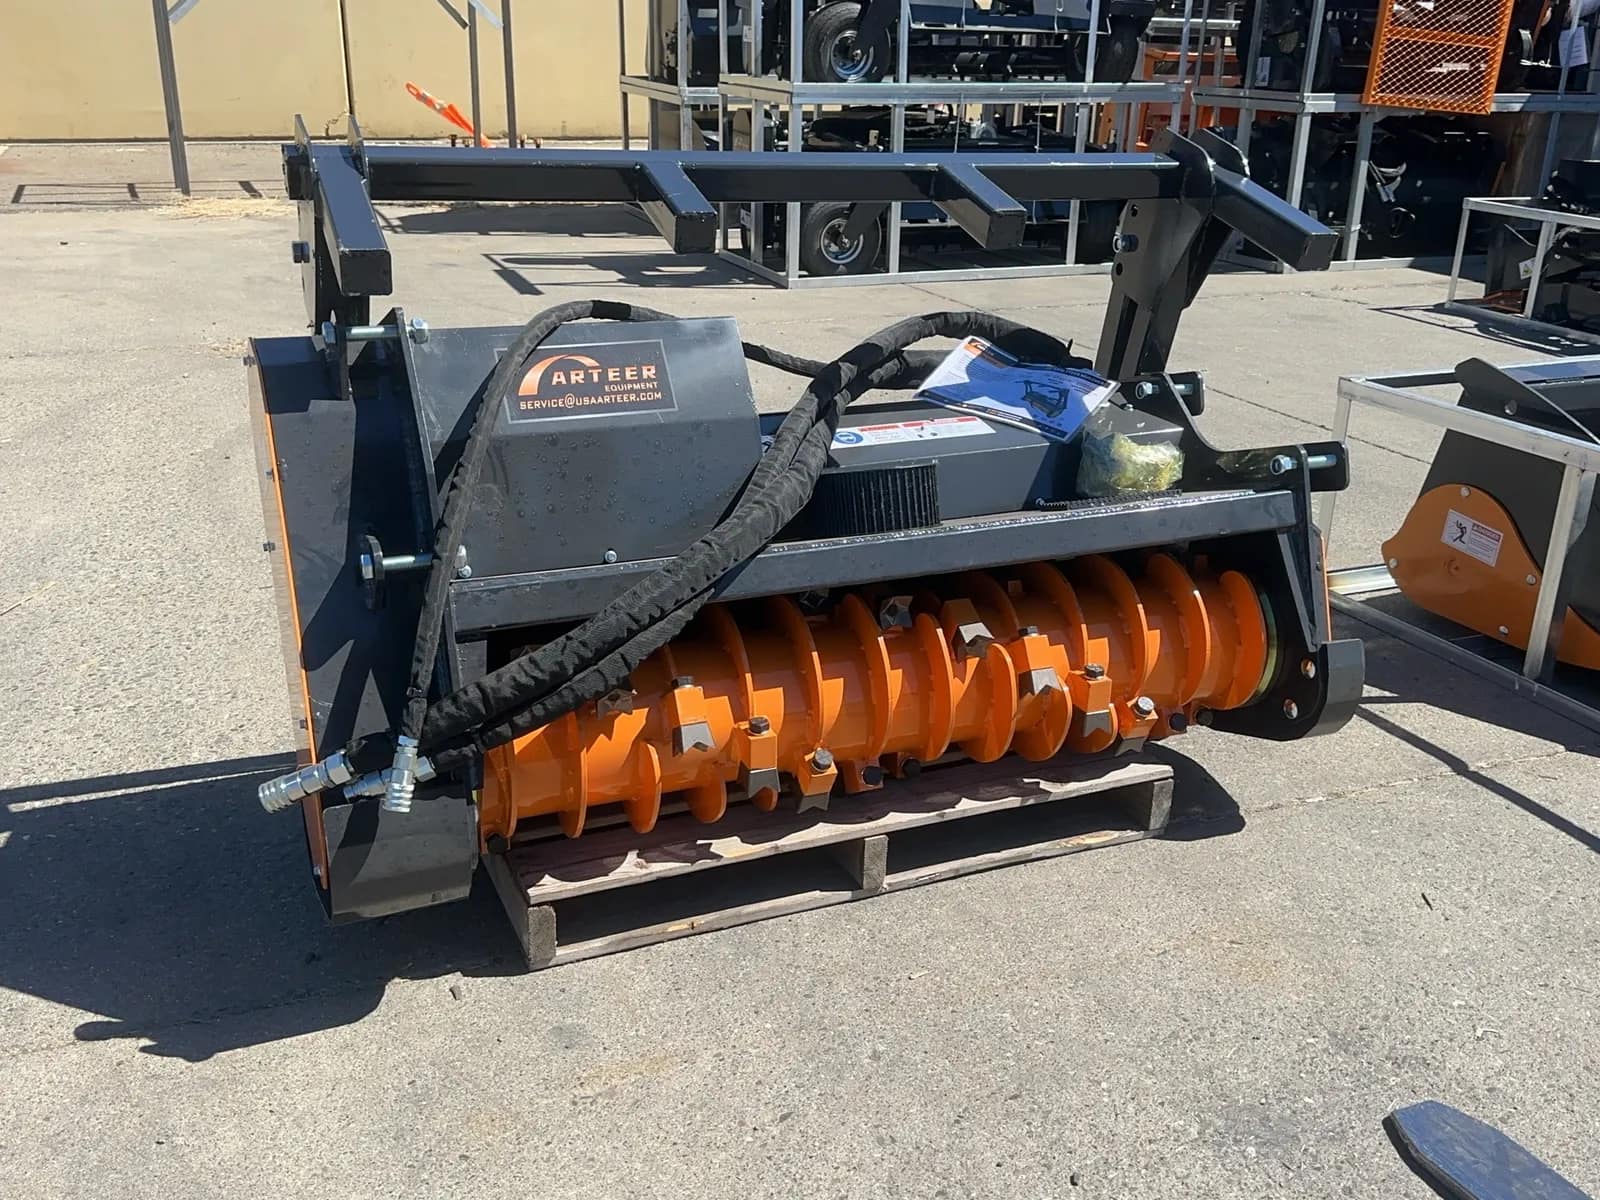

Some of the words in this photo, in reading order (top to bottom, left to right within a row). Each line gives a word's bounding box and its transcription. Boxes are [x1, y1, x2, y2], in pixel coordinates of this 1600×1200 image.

[552, 365, 657, 386] ARTEER
[605, 382, 658, 392] EQUIPMENT
[519, 392, 662, 410] SERVICE@USAARTEER.COM
